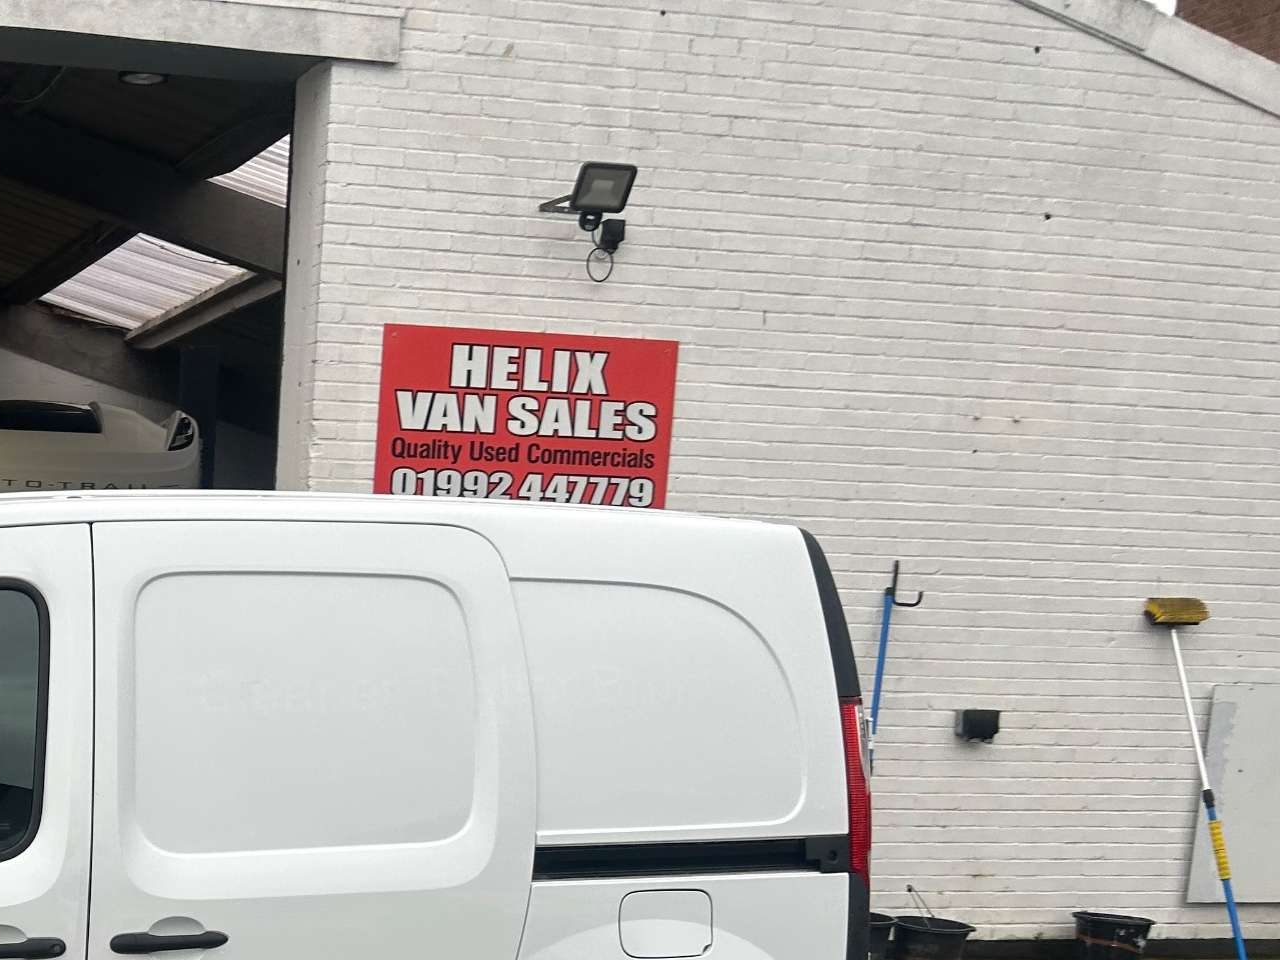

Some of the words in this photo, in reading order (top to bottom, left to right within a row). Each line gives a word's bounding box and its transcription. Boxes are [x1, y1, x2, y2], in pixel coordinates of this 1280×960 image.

[449, 342, 609, 395] HELIX
[395, 389, 498, 434] VAN
[506, 395, 657, 442] SALES
[390, 436, 462, 465] Quality
[470, 441, 519, 464] Used
[527, 443, 655, 469] Commercials
[390, 467, 513, 500] 01992
[518, 471, 655, 507] 447779
